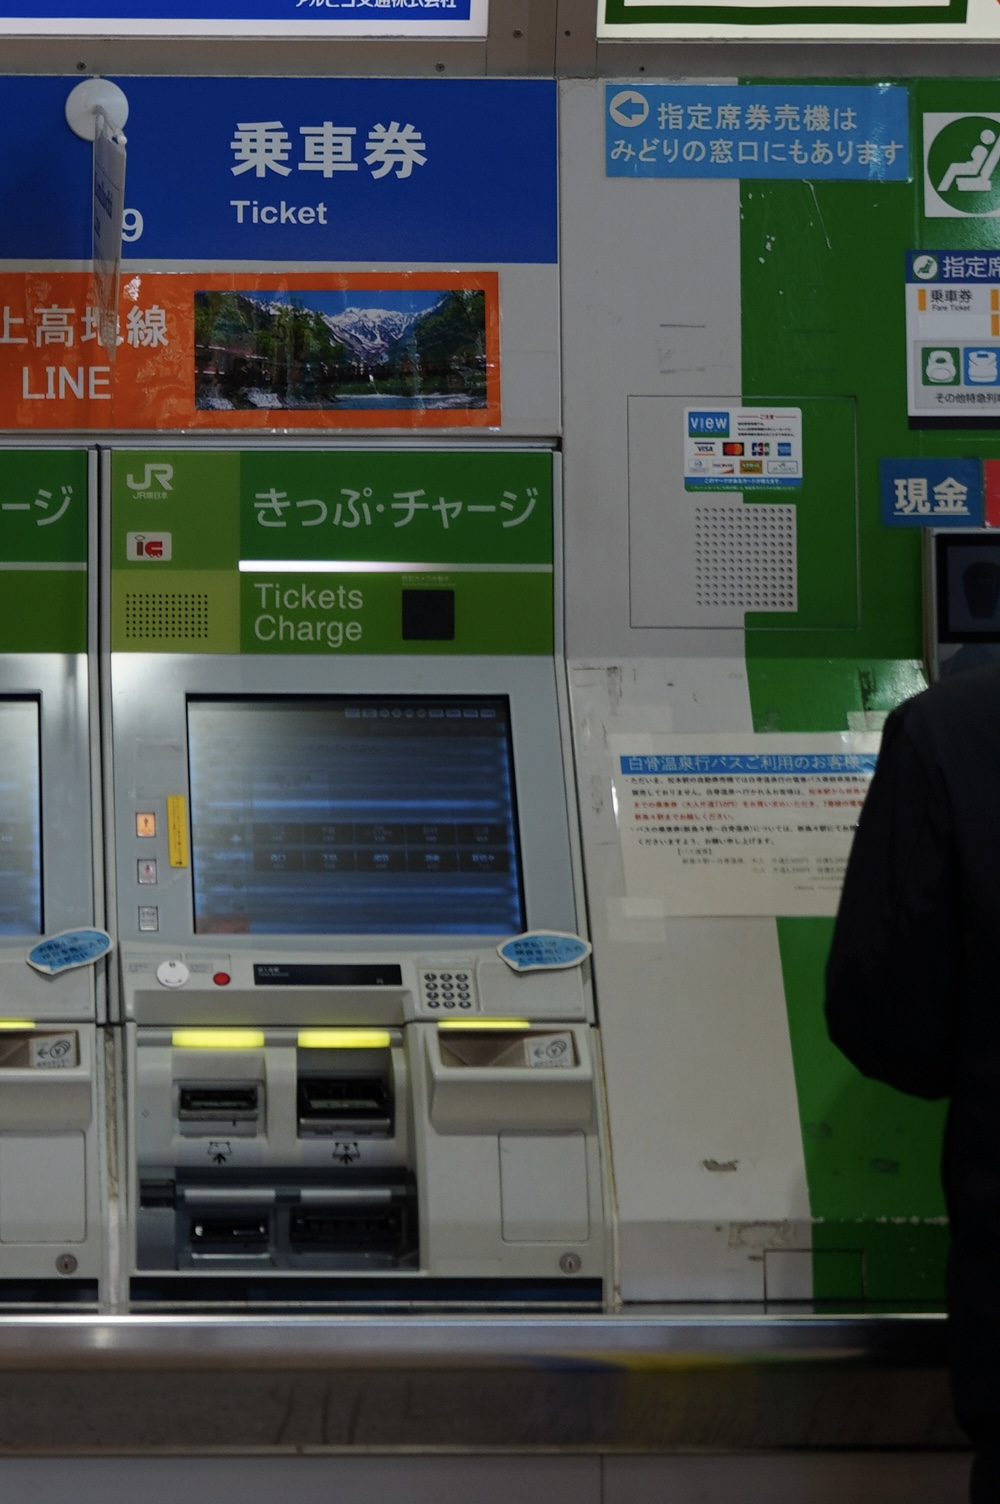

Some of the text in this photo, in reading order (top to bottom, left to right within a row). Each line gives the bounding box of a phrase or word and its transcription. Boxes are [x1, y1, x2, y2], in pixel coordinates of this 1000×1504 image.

[658, 103, 857, 131] 指定席券売機は
[231, 121, 427, 179] 乗車券
[611, 138, 903, 165] みどりの窓口にもあります
[120, 208, 143, 242] 9
[230, 201, 327, 224] Ticket
[932, 290, 972, 302] 乗車券
[23, 366, 111, 399] LINE
[127, 464, 173, 490] JR
[894, 477, 969, 515] 現金
[254, 583, 363, 609] Tickets
[255, 615, 362, 647] Charge
